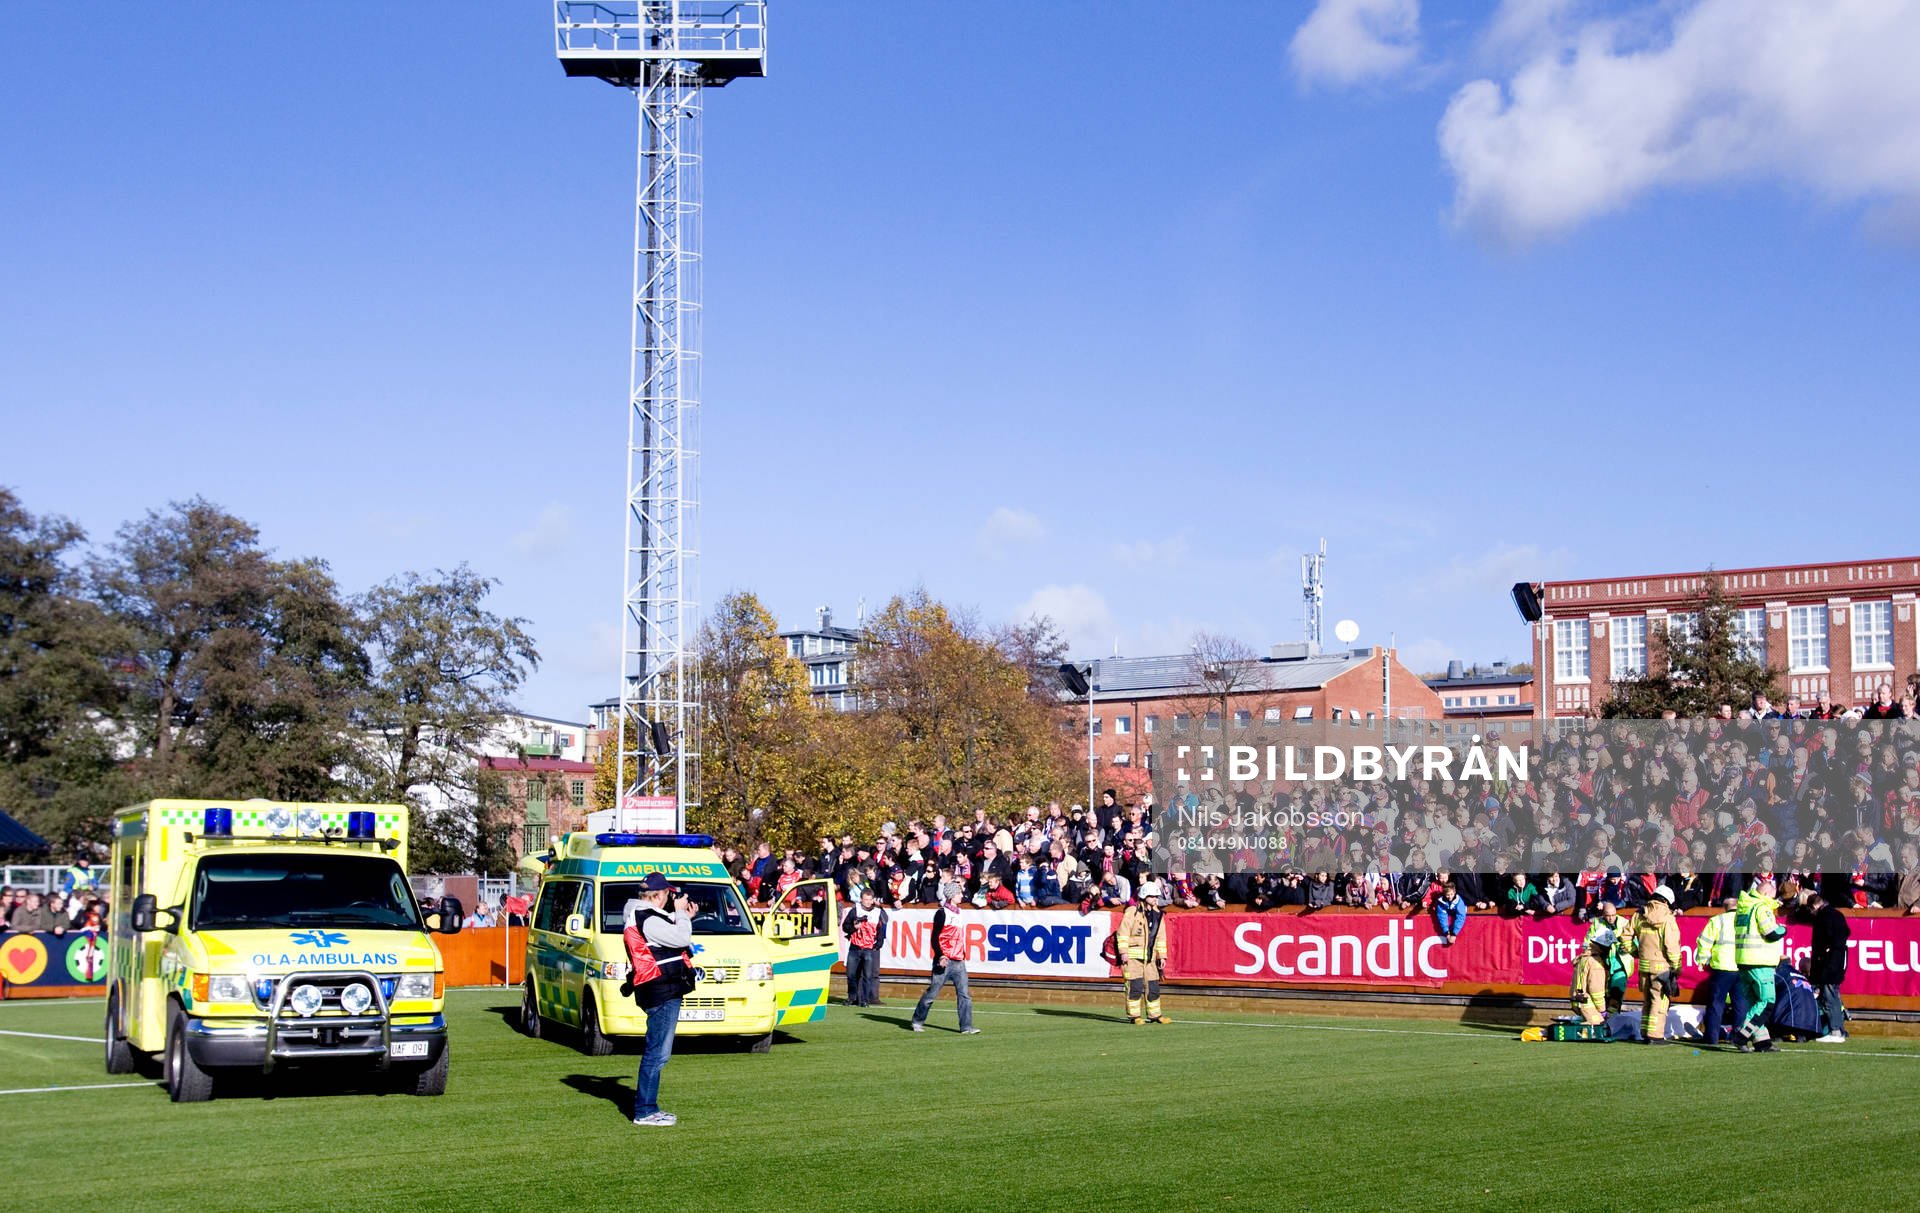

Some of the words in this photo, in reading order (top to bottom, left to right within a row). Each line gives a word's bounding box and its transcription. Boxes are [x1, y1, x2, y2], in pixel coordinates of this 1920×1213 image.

[616, 864, 713, 876] AMBULANS
[892, 920, 1091, 964] INTRSPORT
[1234, 919, 1448, 978] Scandic
[1528, 935, 1580, 964] Ditt
[252, 953, 398, 966] OLA-AMBULANS
